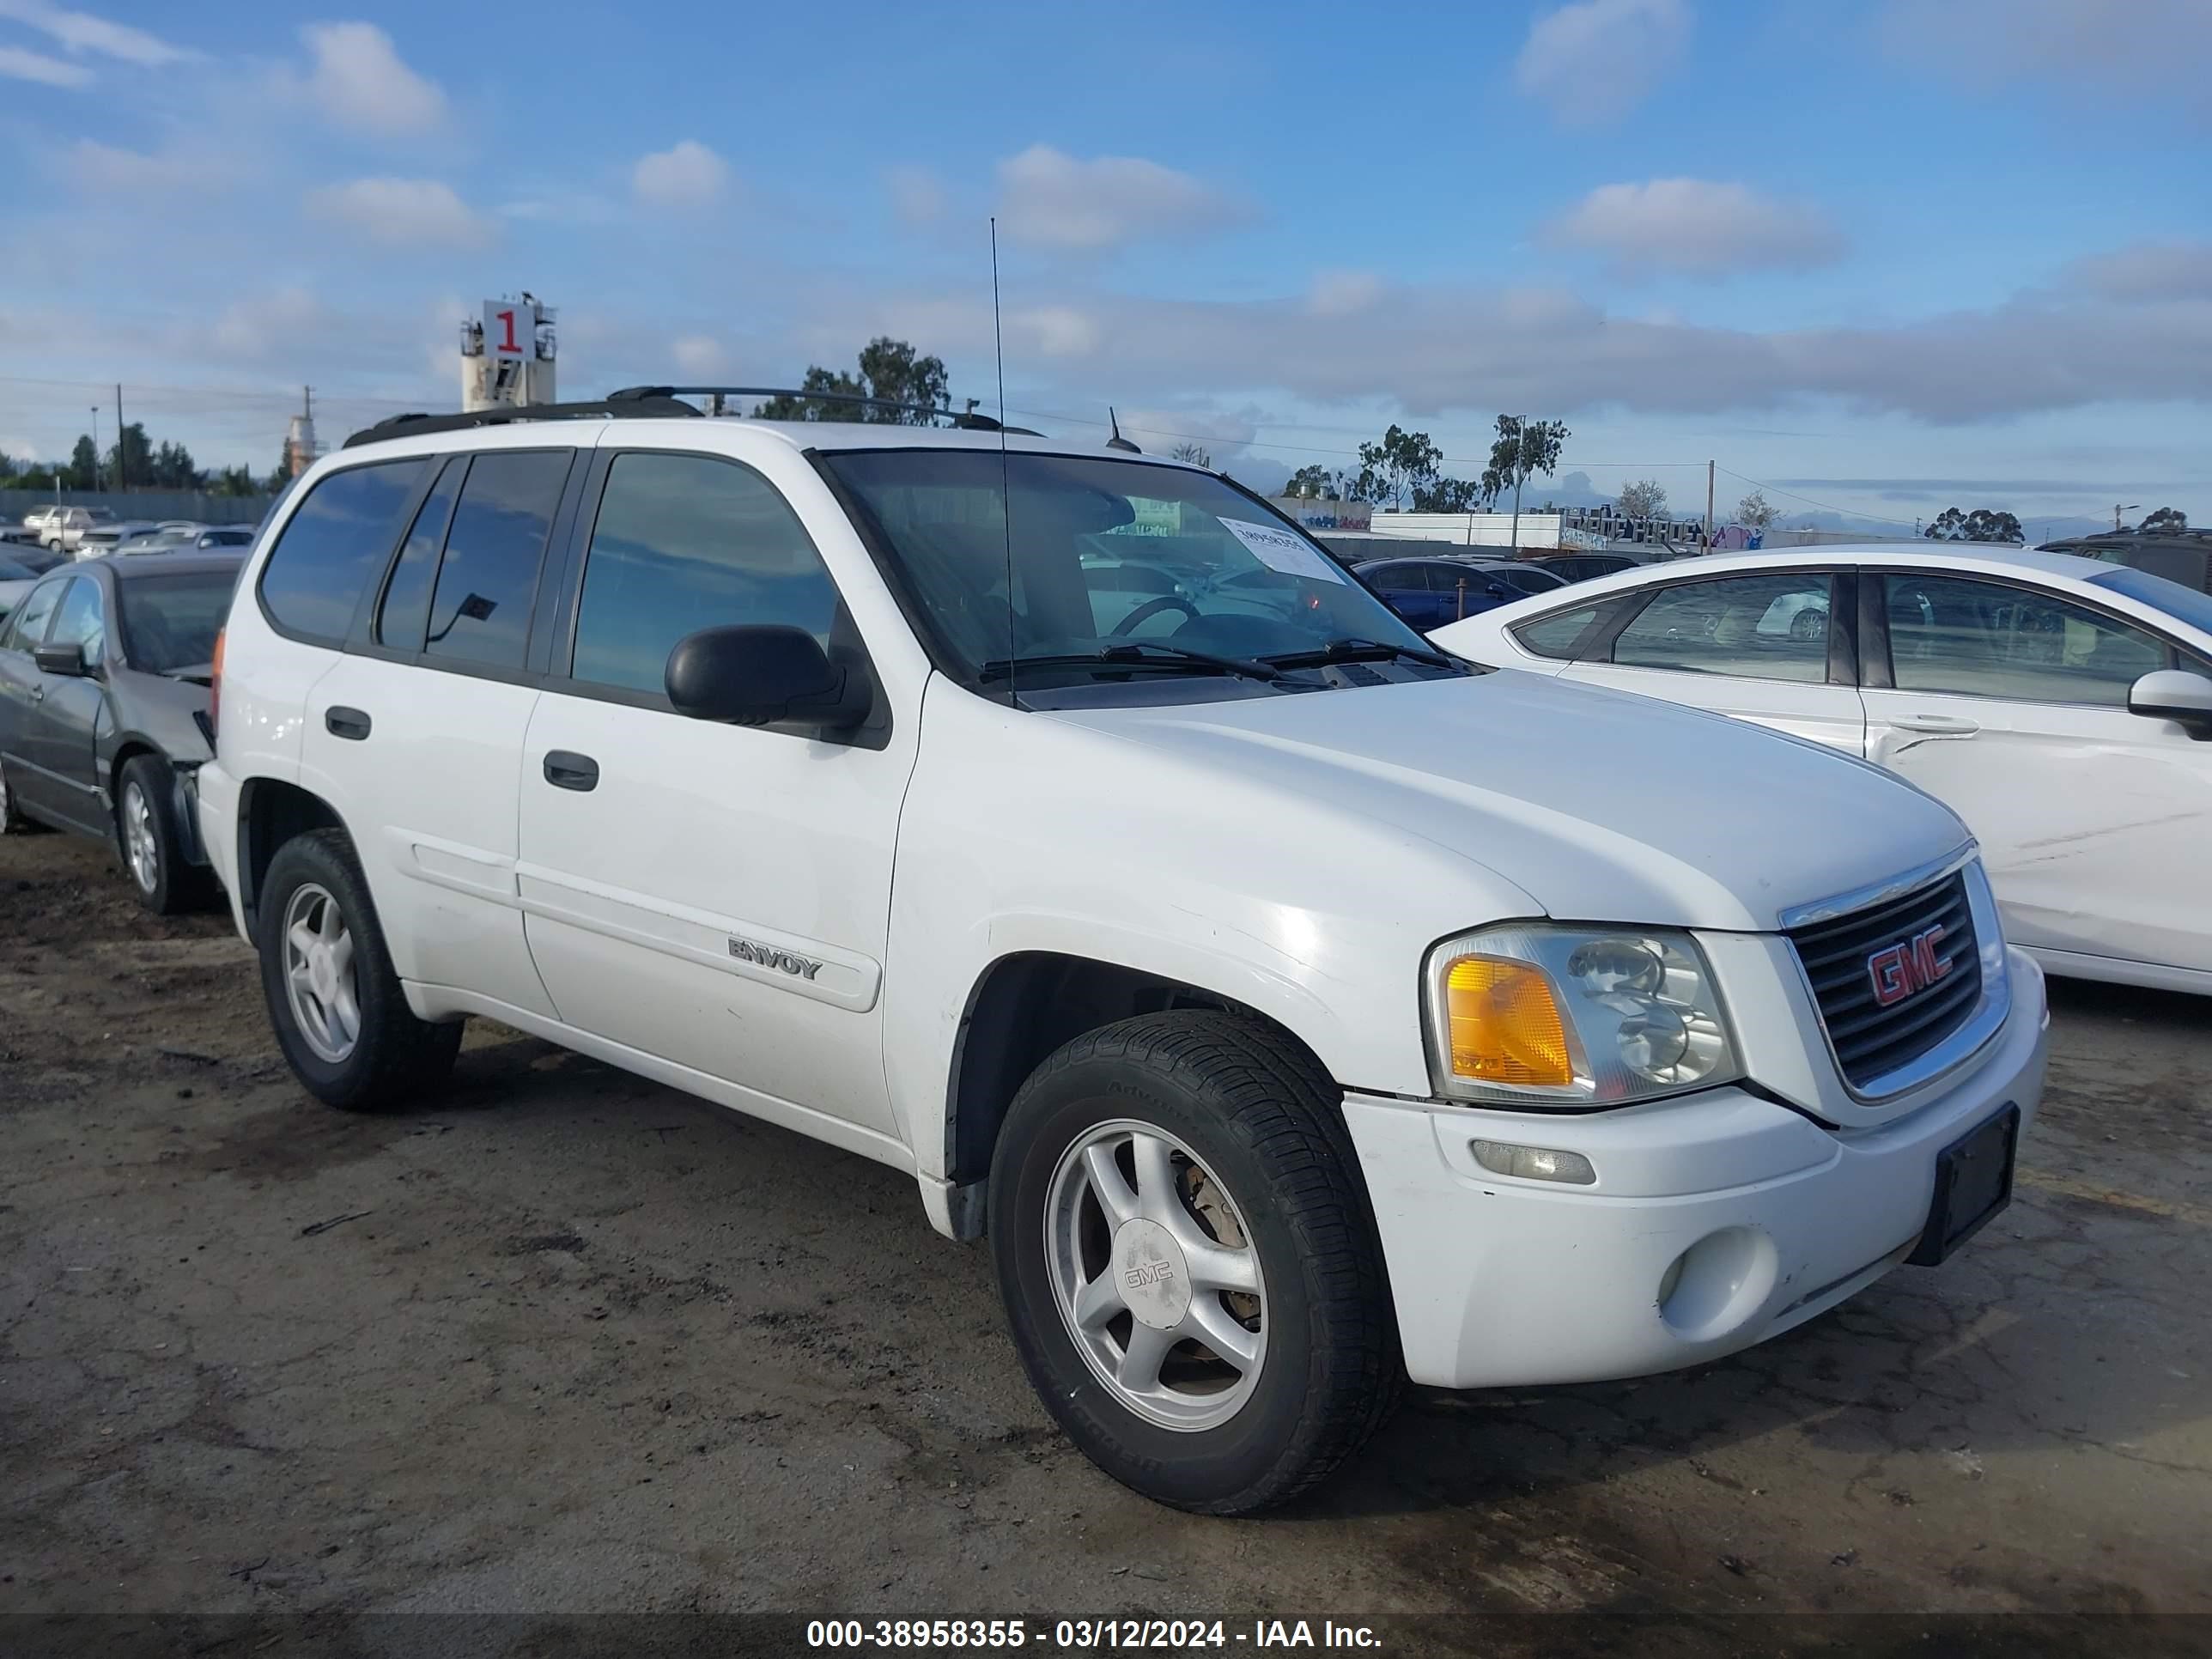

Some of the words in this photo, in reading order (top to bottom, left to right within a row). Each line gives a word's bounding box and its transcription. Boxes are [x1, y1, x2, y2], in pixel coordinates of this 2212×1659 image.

[495, 309, 523, 353] 1
[1237, 529, 1304, 550] 38958355
[727, 937, 823, 981] ENVOY
[1868, 924, 1954, 1007] GMC
[1124, 1261, 1173, 1289] GMC
